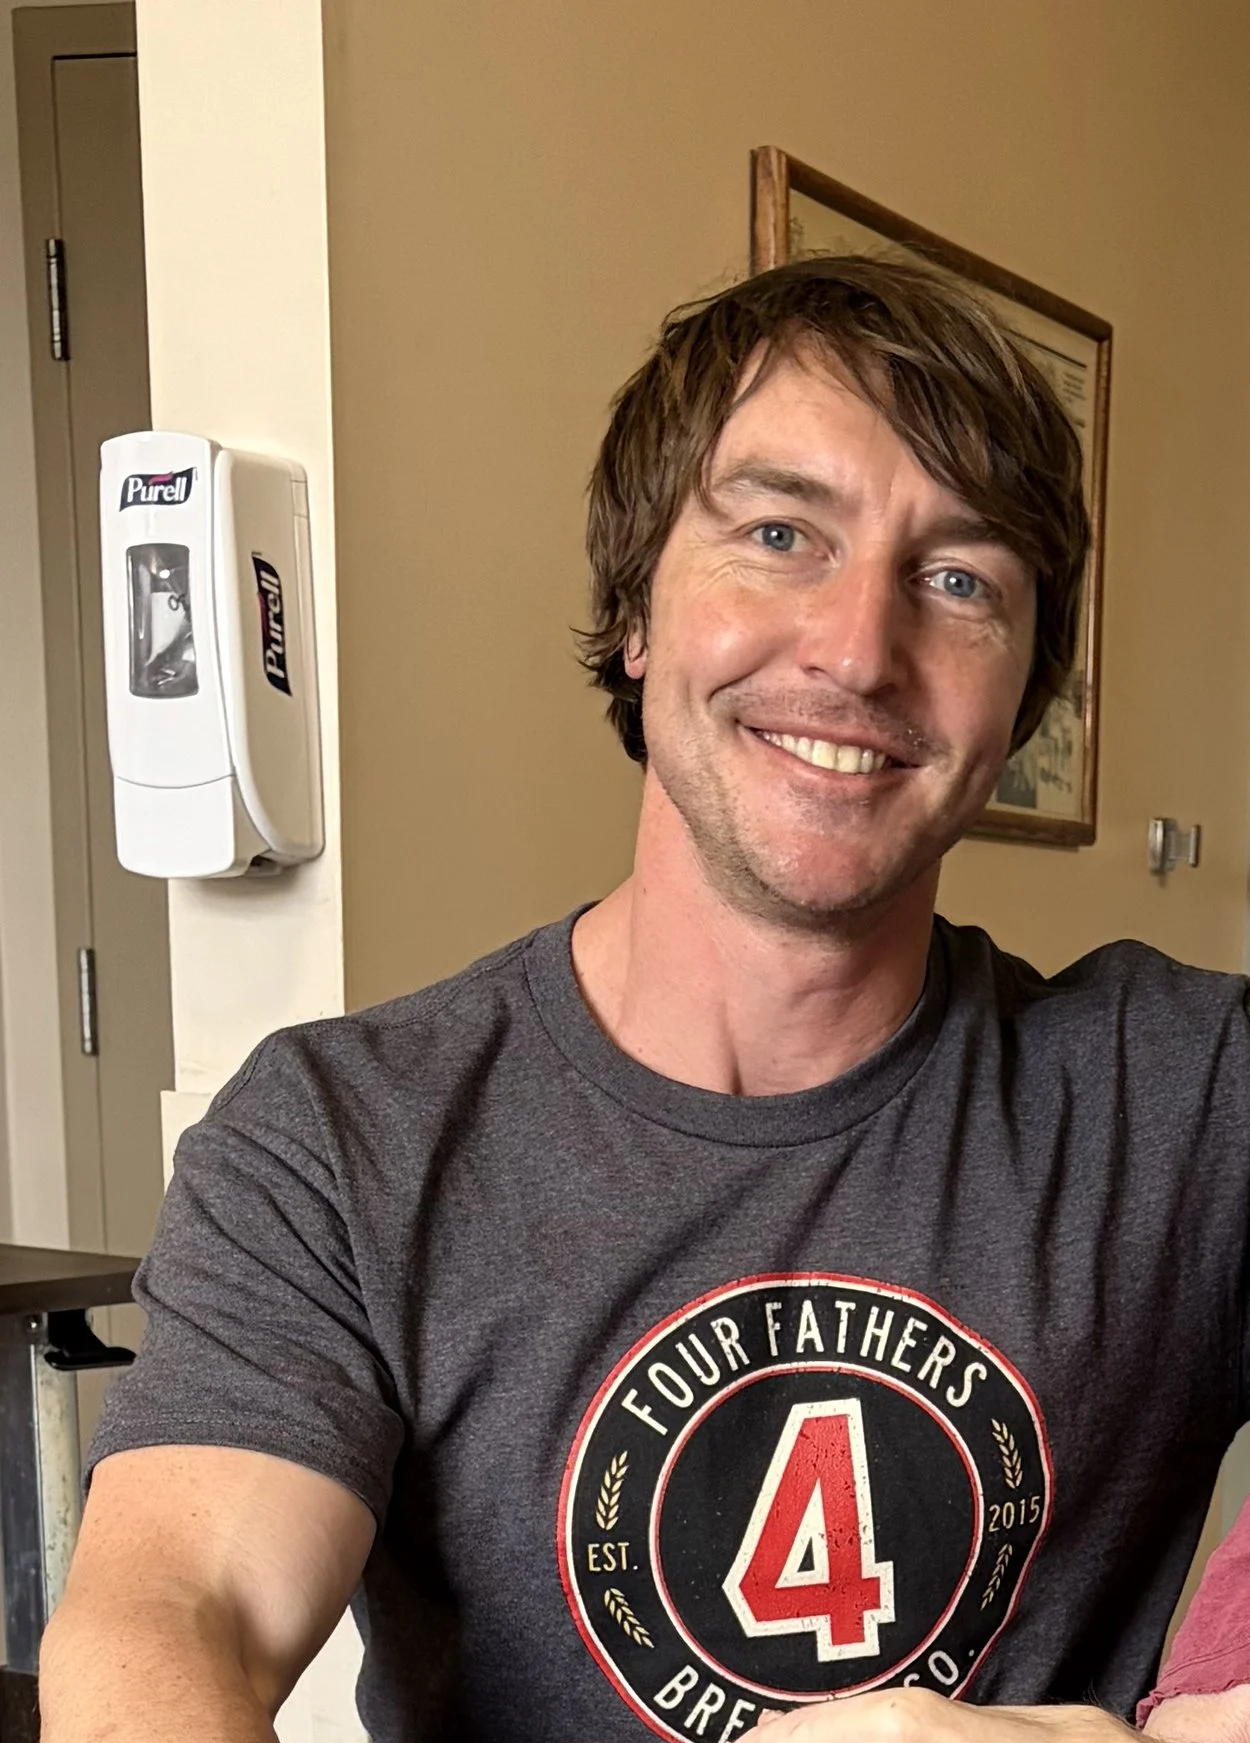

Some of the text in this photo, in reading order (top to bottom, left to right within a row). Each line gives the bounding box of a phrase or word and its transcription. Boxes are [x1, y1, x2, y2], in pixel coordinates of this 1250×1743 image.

[127, 477, 187, 503] Purell
[621, 1299, 988, 1436] FOUR FATHERS
[722, 1397, 896, 1663] 4
[988, 1496, 1041, 1533] 2015
[587, 1543, 639, 1572] EST.
